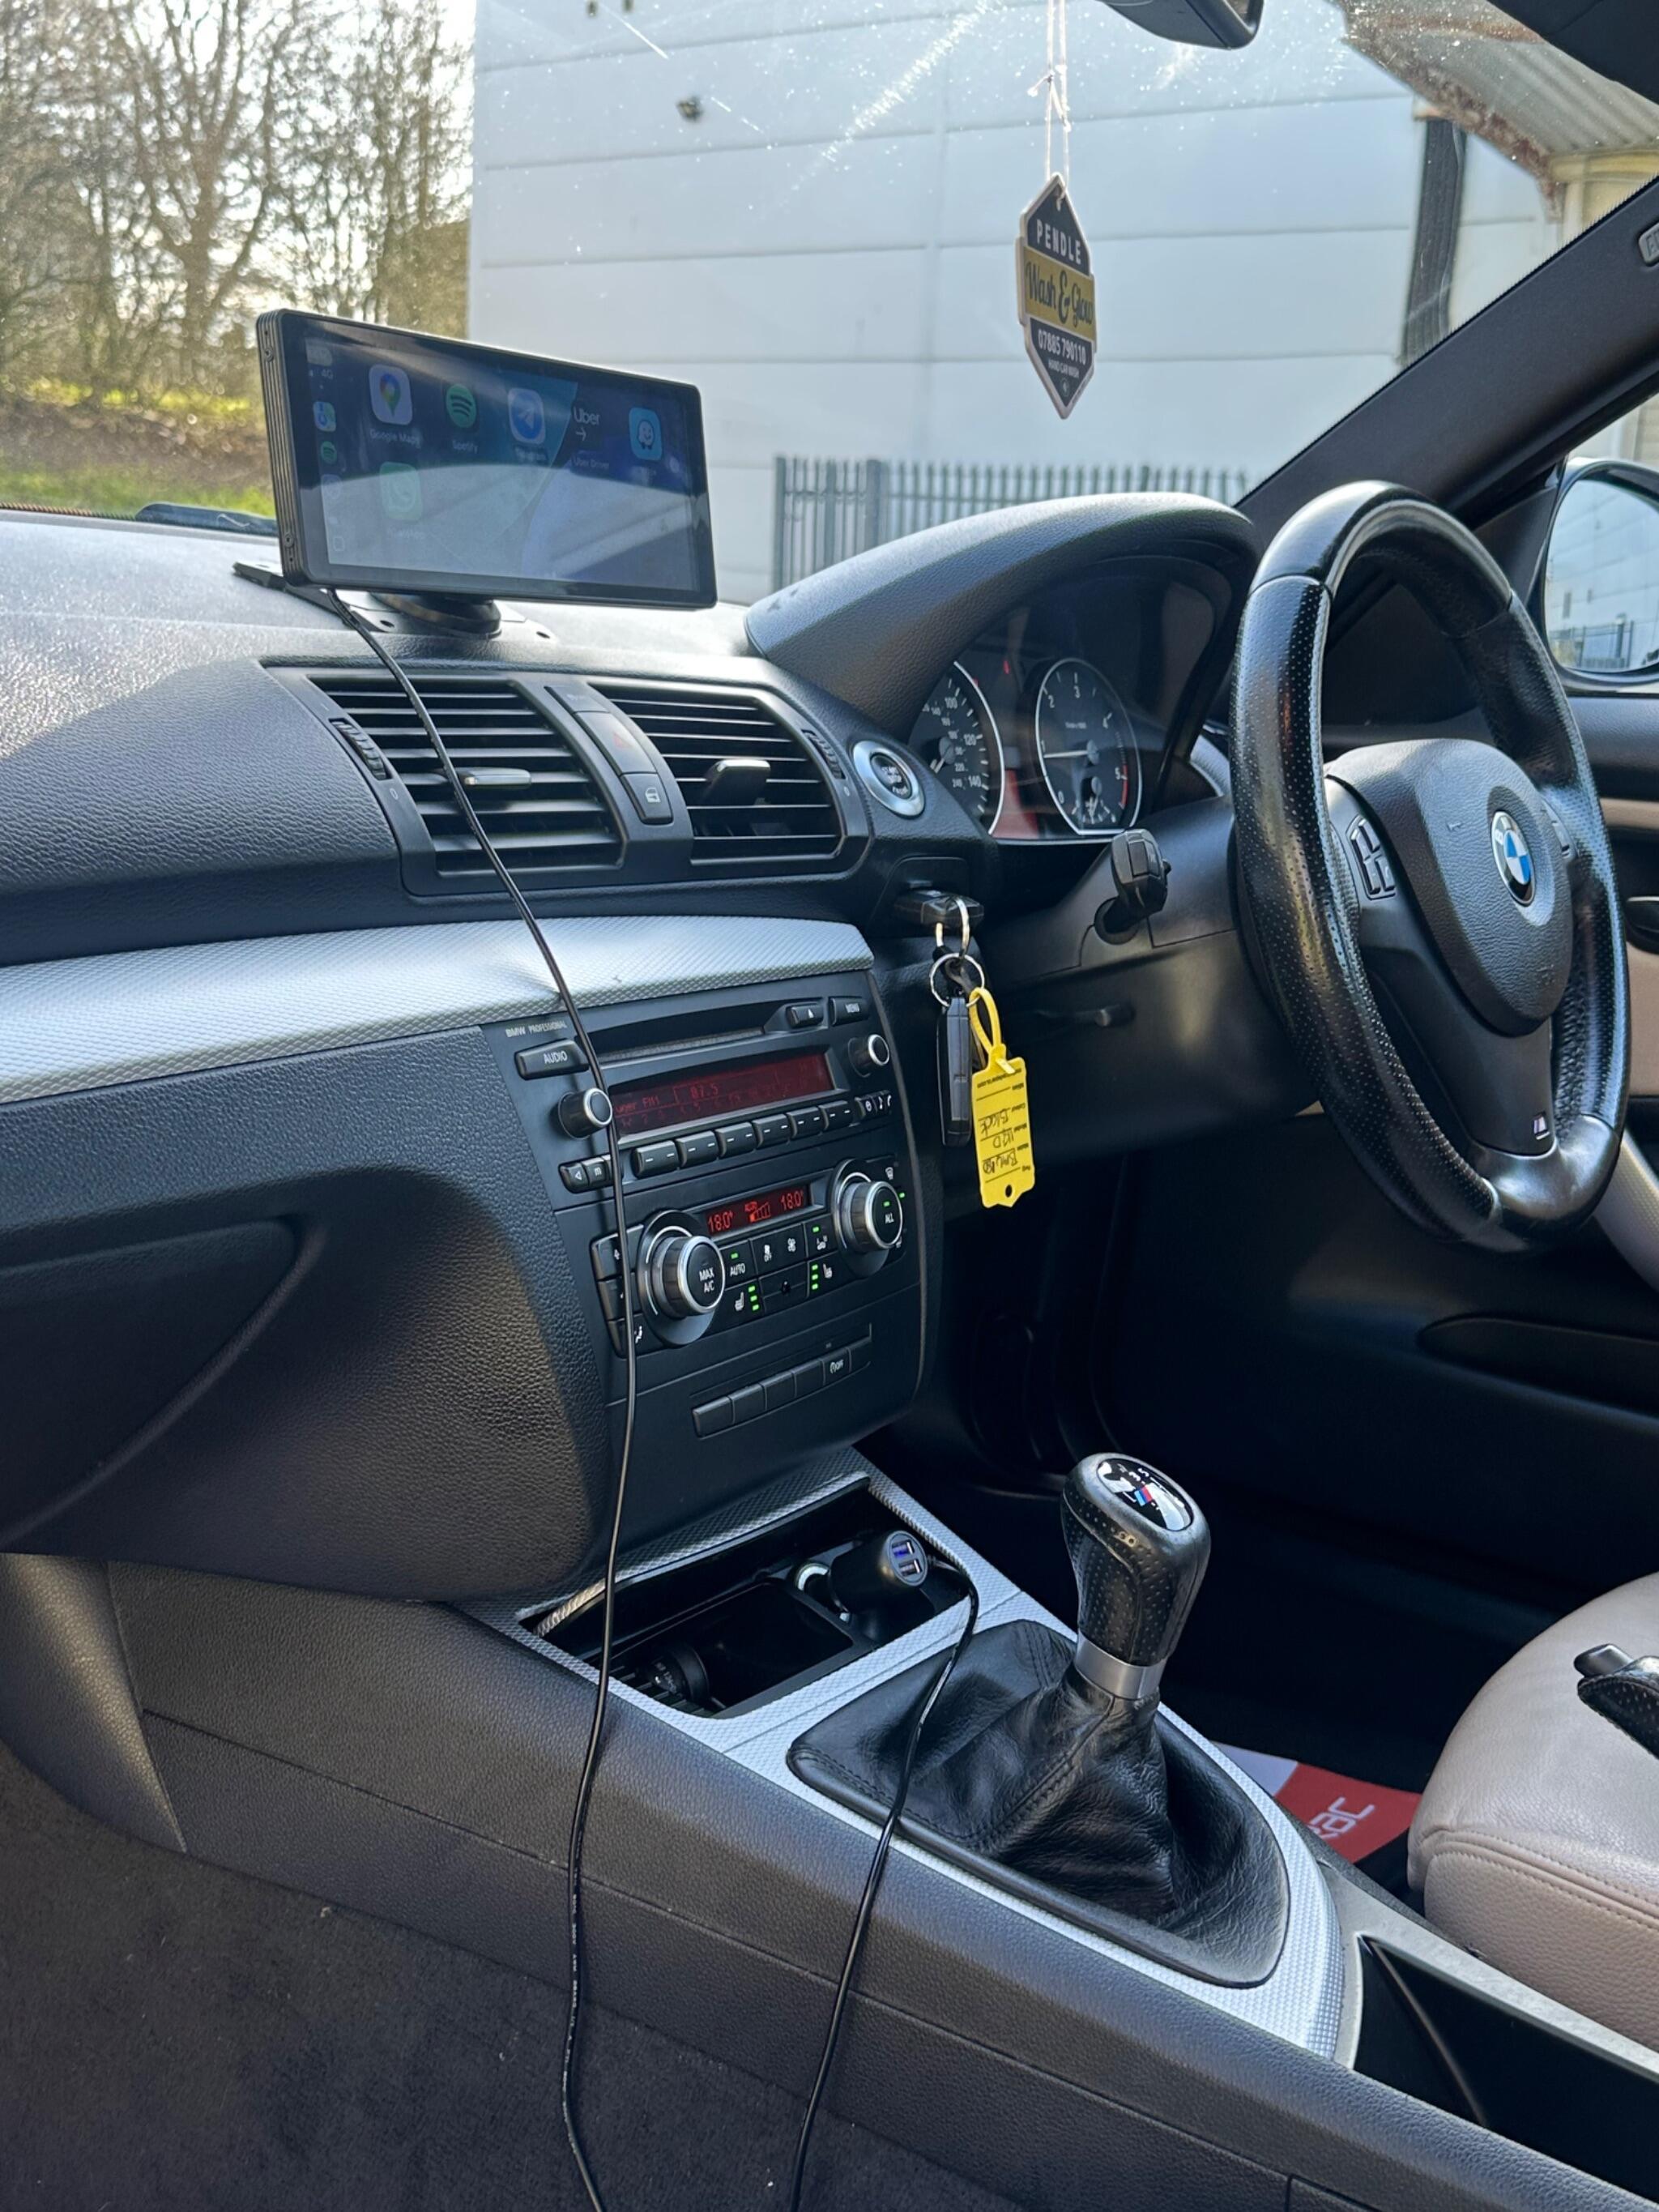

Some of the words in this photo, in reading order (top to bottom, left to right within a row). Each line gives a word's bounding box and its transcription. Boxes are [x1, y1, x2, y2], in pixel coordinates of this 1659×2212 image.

[1035, 219, 1082, 265] PENDLE
[1026, 261, 1057, 310] Wash
[1058, 269, 1071, 324] &
[572, 406, 601, 425] Uber
[1074, 685, 1081, 698] 3
[945, 697, 958, 709] 100
[1047, 694, 1055, 708] 2
[963, 733, 977, 746] 120
[1114, 767, 1122, 780] 5
[968, 775, 982, 788] 140
[1058, 790, 1064, 805] 0
[505, 1026, 526, 1037] BMW
[544, 1050, 568, 1064] AUDIO
[698, 1266, 715, 1281] MAX
[730, 1262, 746, 1277] AUTO
[703, 1280, 715, 1293] A/C
